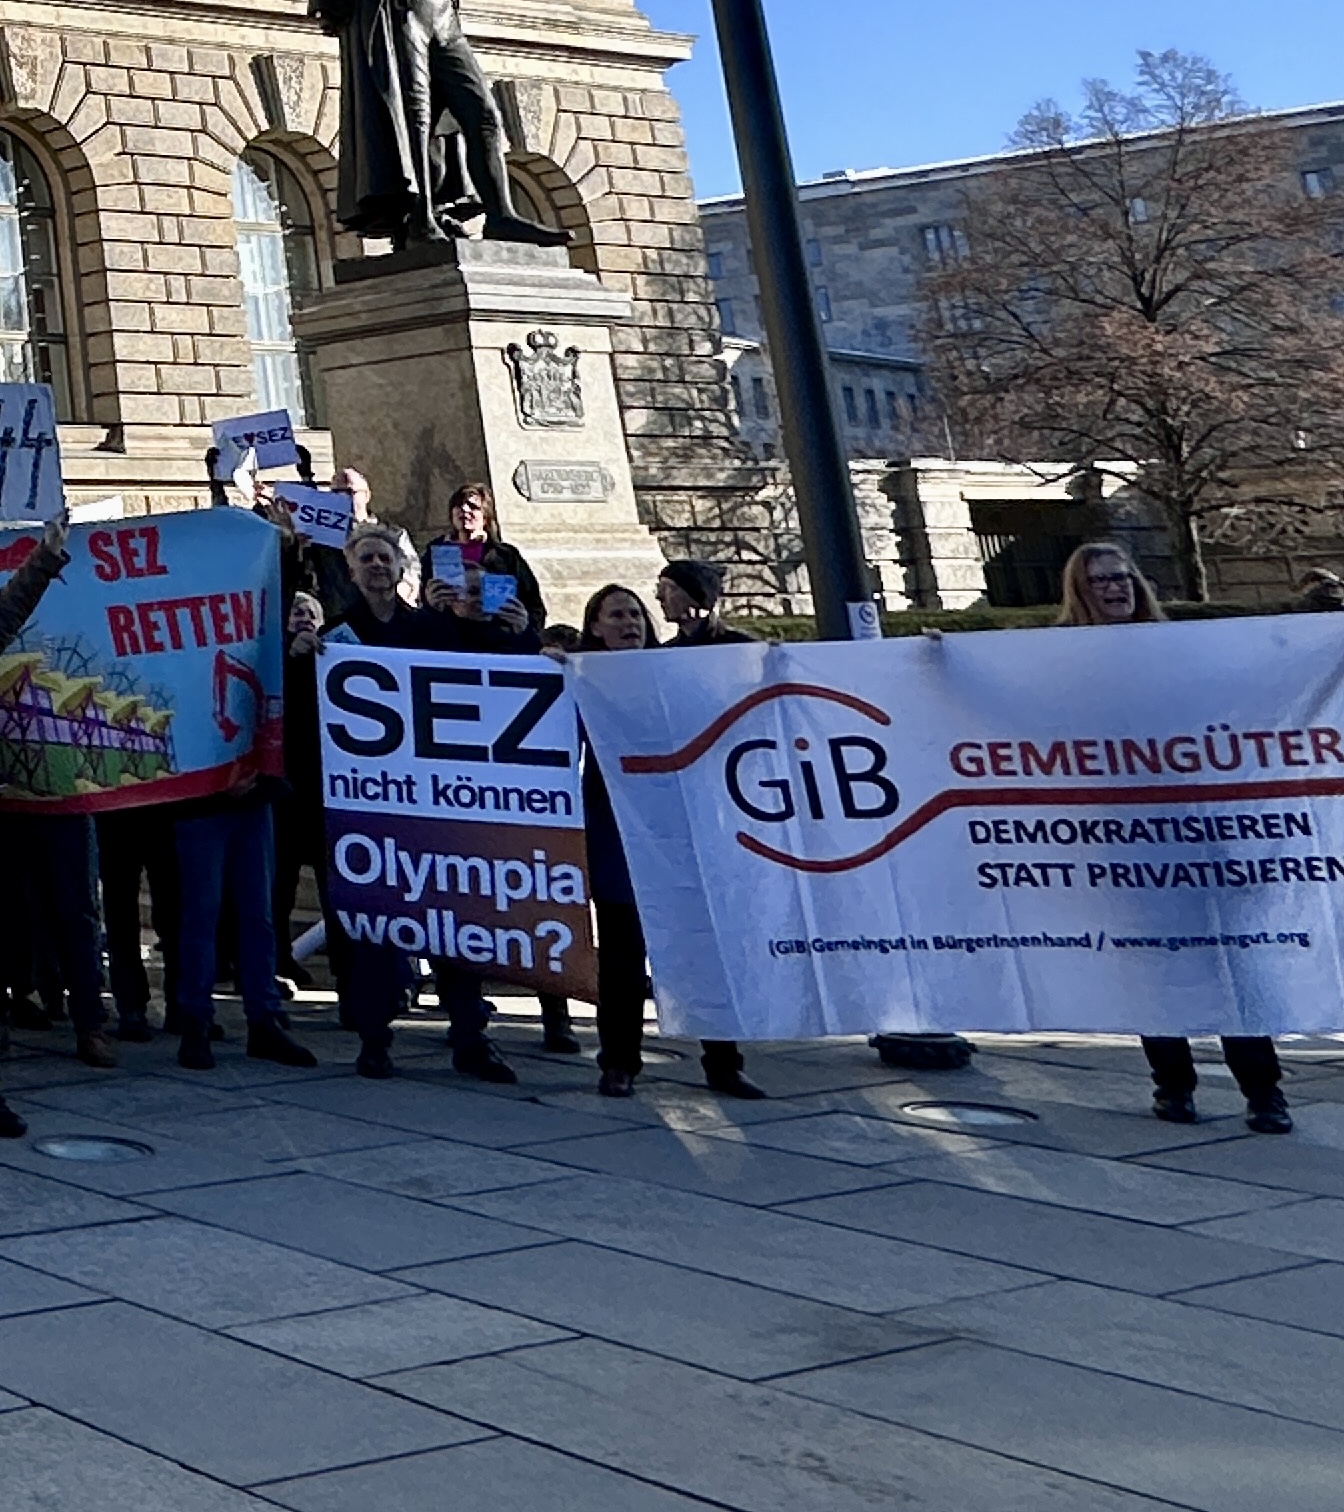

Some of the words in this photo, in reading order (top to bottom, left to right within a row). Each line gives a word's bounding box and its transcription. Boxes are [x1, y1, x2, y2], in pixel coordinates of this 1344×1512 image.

[256, 426, 292, 445] SEZ
[299, 503, 349, 532] SEZ
[88, 525, 170, 582] SEZ
[105, 587, 266, 658] RETTEN!
[324, 660, 571, 768] SEZ
[949, 723, 1344, 778] GEMEINGÜTER
[328, 768, 417, 805] nicht
[431, 774, 572, 816] können
[724, 736, 901, 823] GiB
[968, 812, 1313, 845] DEMOKRATISIEREN
[334, 832, 587, 912] Olympia
[977, 862, 1075, 890] STATT
[336, 908, 573, 974] wollen?
[910, 934, 930, 951] in
